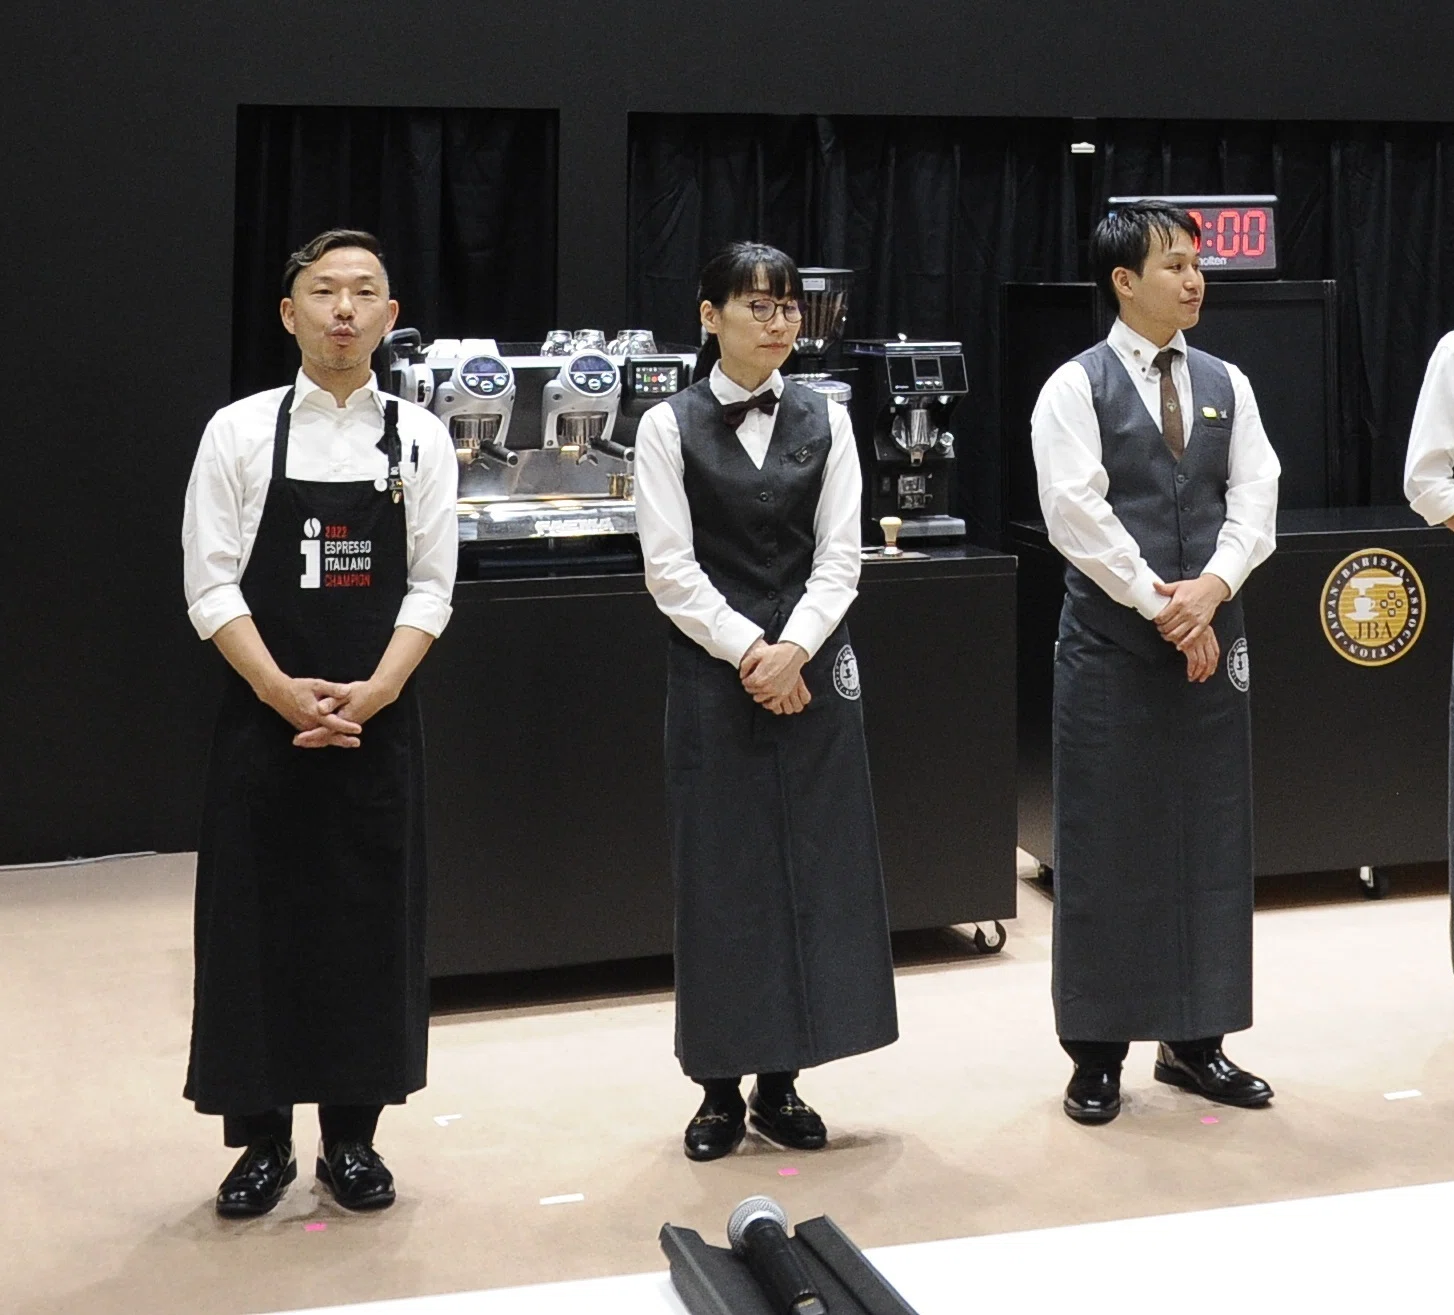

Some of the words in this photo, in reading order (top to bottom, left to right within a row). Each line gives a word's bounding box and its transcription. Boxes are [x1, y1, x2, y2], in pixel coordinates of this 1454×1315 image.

[324, 540, 372, 554] ESPRESSO
[324, 557, 372, 571] ITALIANO
[1341, 556, 1406, 579] BARISTA
[324, 573, 372, 587] CHAMPION
[1327, 586, 1346, 640] JAPAN
[1348, 586, 1419, 659] ASSOCIATION
[1354, 620, 1394, 639] JBA
